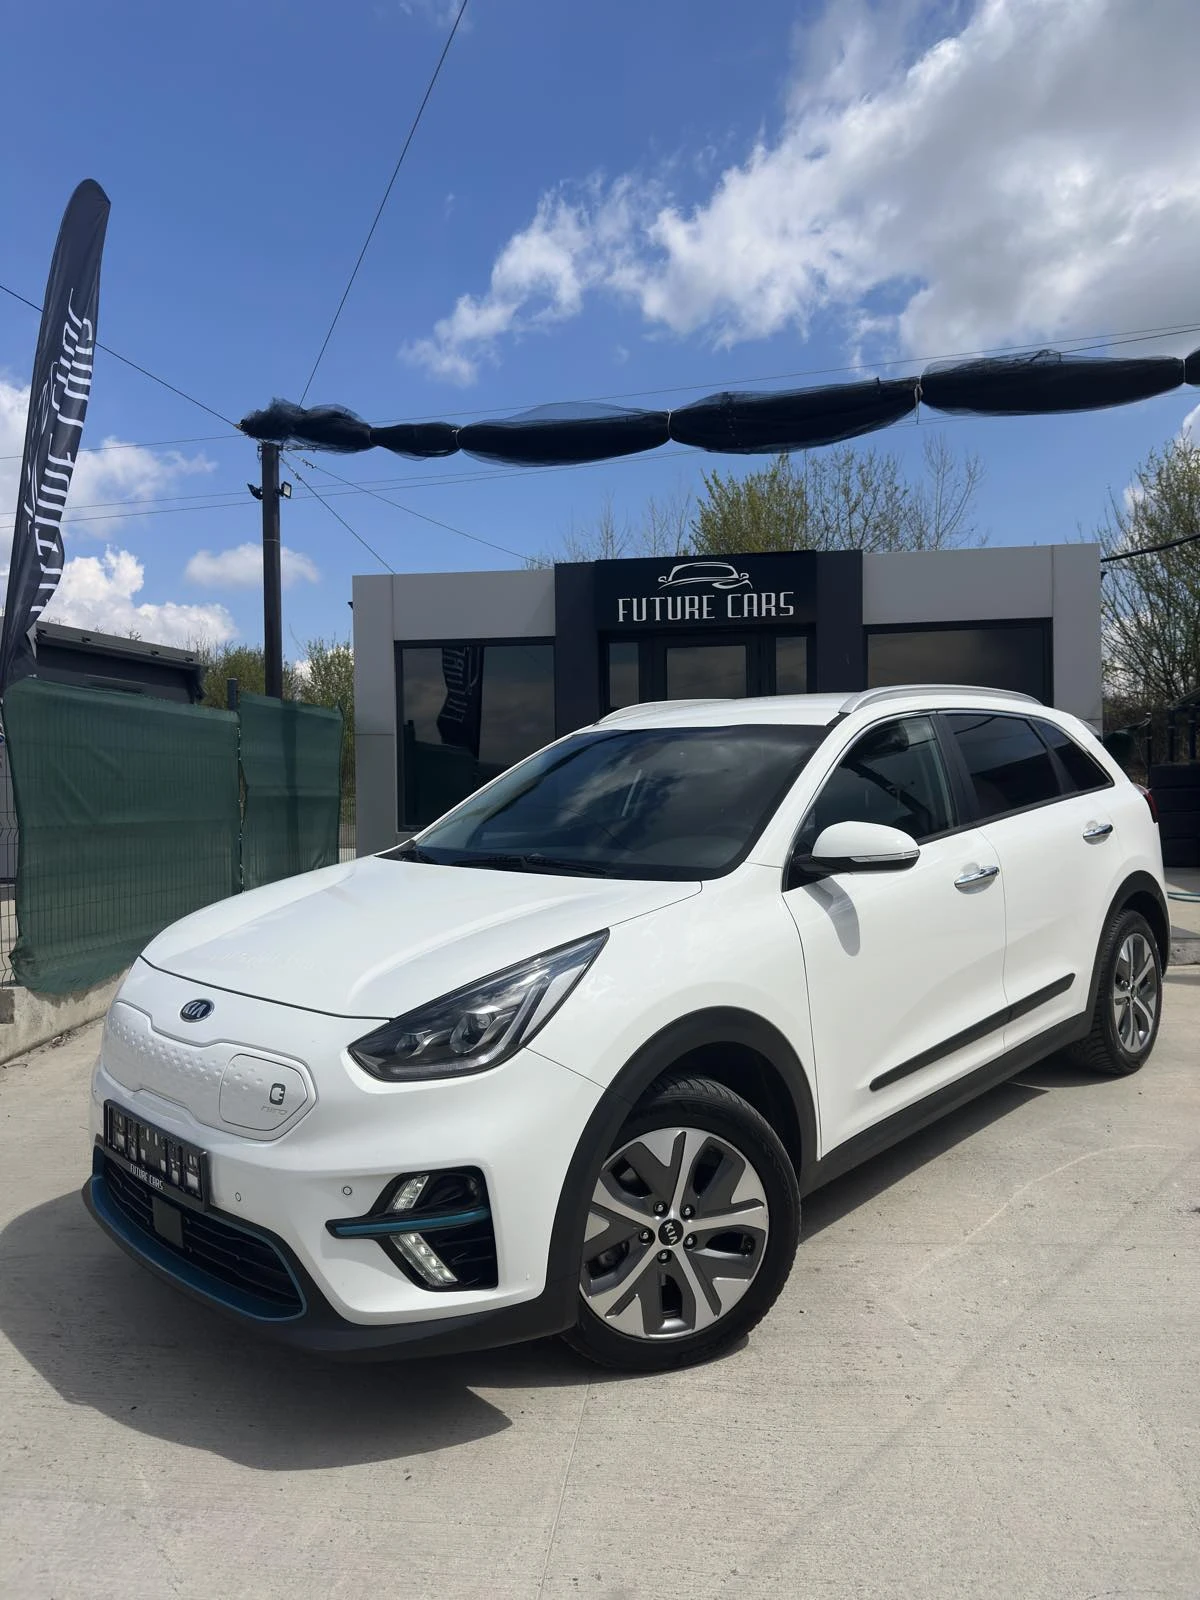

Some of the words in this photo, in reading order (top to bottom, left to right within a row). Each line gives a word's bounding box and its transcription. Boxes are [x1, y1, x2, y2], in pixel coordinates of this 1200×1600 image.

[618, 595, 715, 622] FUTURE
[728, 592, 794, 618] CARS
[182, 1001, 207, 1018] KIA
[131, 1164, 148, 1181] FUTURE
[149, 1175, 163, 1191] CARS
[665, 1222, 678, 1244] KIA
